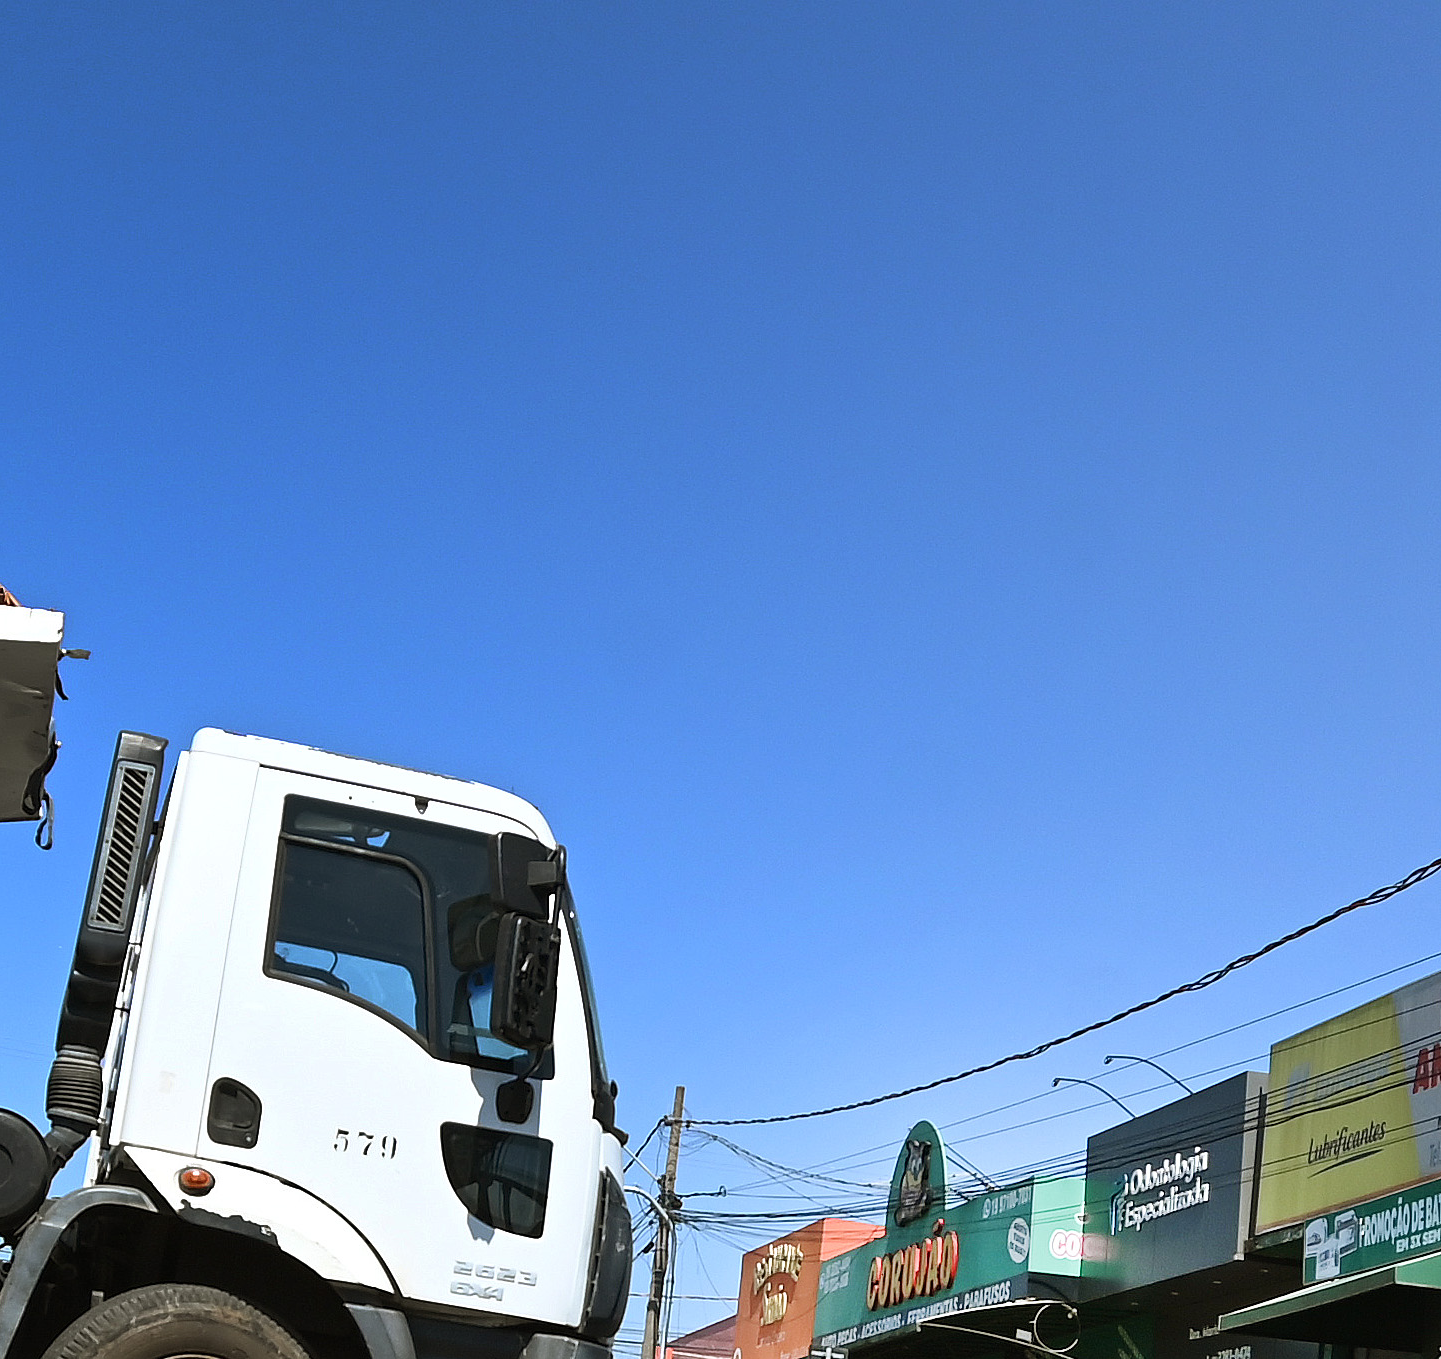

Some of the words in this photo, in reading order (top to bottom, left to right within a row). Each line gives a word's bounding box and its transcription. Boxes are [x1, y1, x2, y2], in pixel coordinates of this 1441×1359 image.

[333, 1128, 397, 1159] 579
[1307, 1119, 1387, 1164] Lubrificantes
[1129, 1146, 1210, 1196] Odontologia
[1123, 1176, 1211, 1232] Especializada
[1359, 1196, 1410, 1248] PROMOÇÃO
[1410, 1198, 1425, 1233] DE
[1422, 1226, 1441, 1246] SEM
[453, 1260, 538, 1287] 2623
[867, 1218, 960, 1311] CORUJÃO
[963, 1280, 1011, 1310] PARAFUSOS
